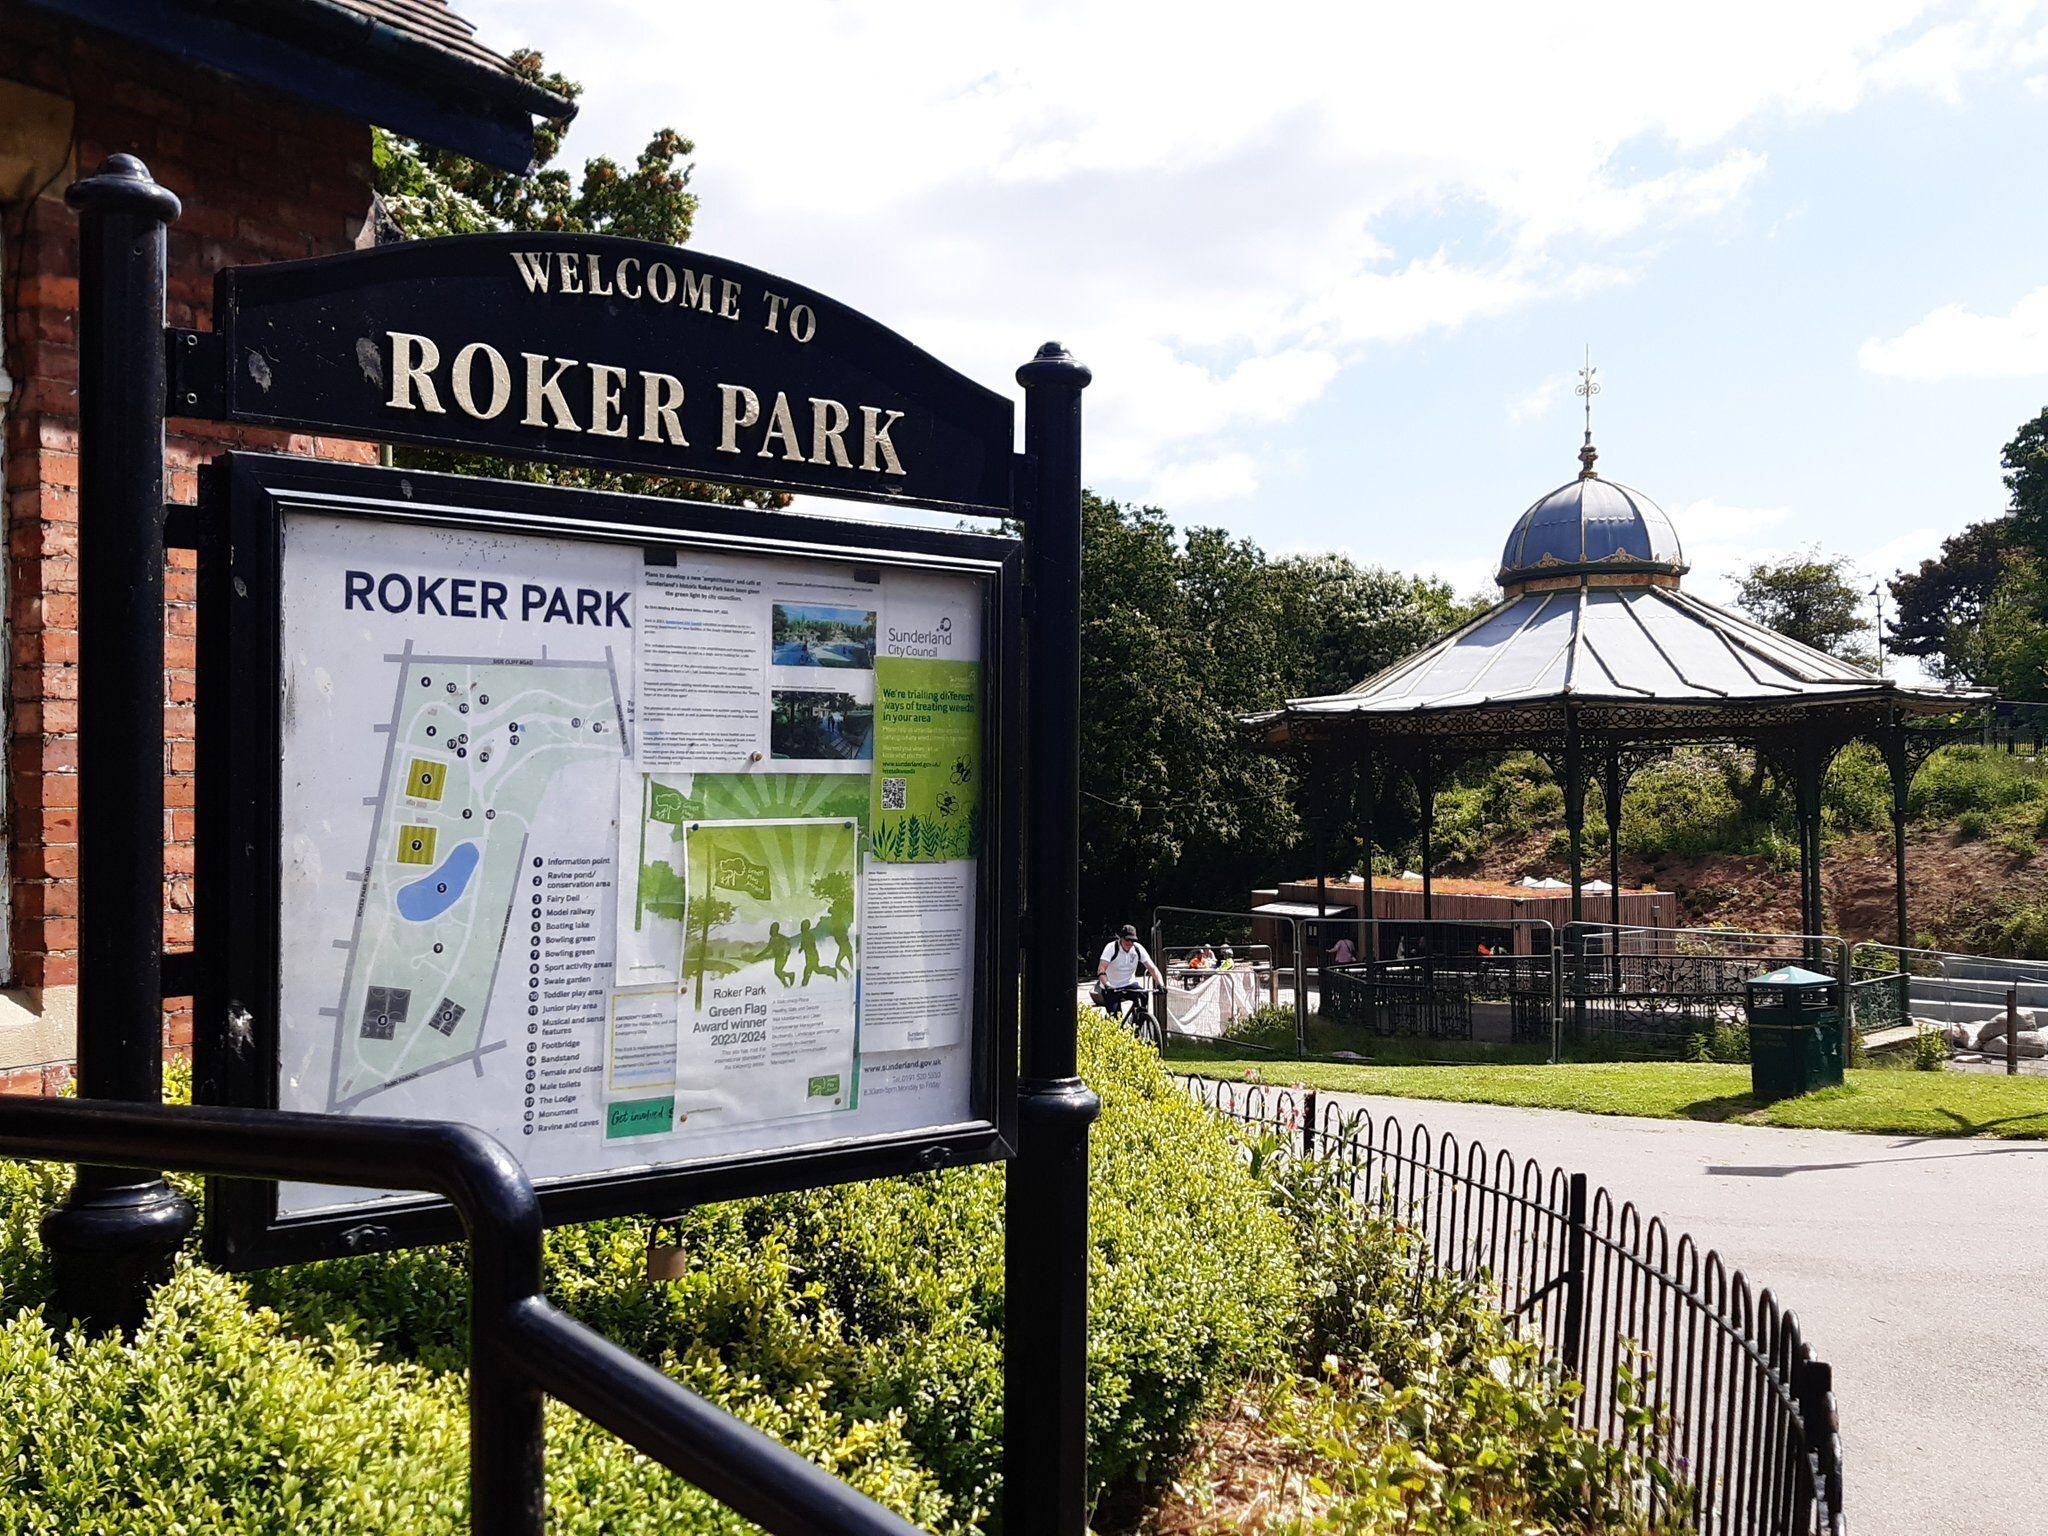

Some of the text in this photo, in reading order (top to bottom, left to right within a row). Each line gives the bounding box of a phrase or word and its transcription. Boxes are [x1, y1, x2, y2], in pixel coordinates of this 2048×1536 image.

[510, 252, 817, 343] WELCOME TO
[385, 331, 907, 476] ROKER PARK
[344, 570, 632, 628] ROKER PARK
[888, 628, 952, 646] Sunderland
[888, 644, 937, 657] City Council
[883, 689, 974, 702] We're trialling different
[883, 702, 904, 711] ways
[916, 704, 948, 714] treating
[883, 712, 891, 721] in
[892, 714, 912, 723] your
[592, 857, 610, 866] point
[574, 870, 596, 880] pond/
[570, 908, 595, 916] railway
[544, 964, 564, 972] Sport
[566, 962, 592, 970] activity
[566, 976, 591, 985] garden
[713, 986, 767, 999] Roker Park
[542, 1005, 565, 1013] Junior
[566, 1004, 581, 1012] play
[709, 1003, 767, 1017] Green Flag
[542, 1018, 570, 1026] Musical
[693, 1018, 767, 1033] Award winner
[711, 1031, 766, 1046] 2023/2024
[542, 1041, 580, 1049] Footbridge
[541, 1054, 580, 1063] Bandstand
[541, 1068, 566, 1076] Female
[864, 1059, 941, 1073] www.sunderland.gov.uk
[539, 1108, 578, 1118] Monument
[611, 1111, 628, 1125] Get
[631, 1106, 664, 1120] involved
